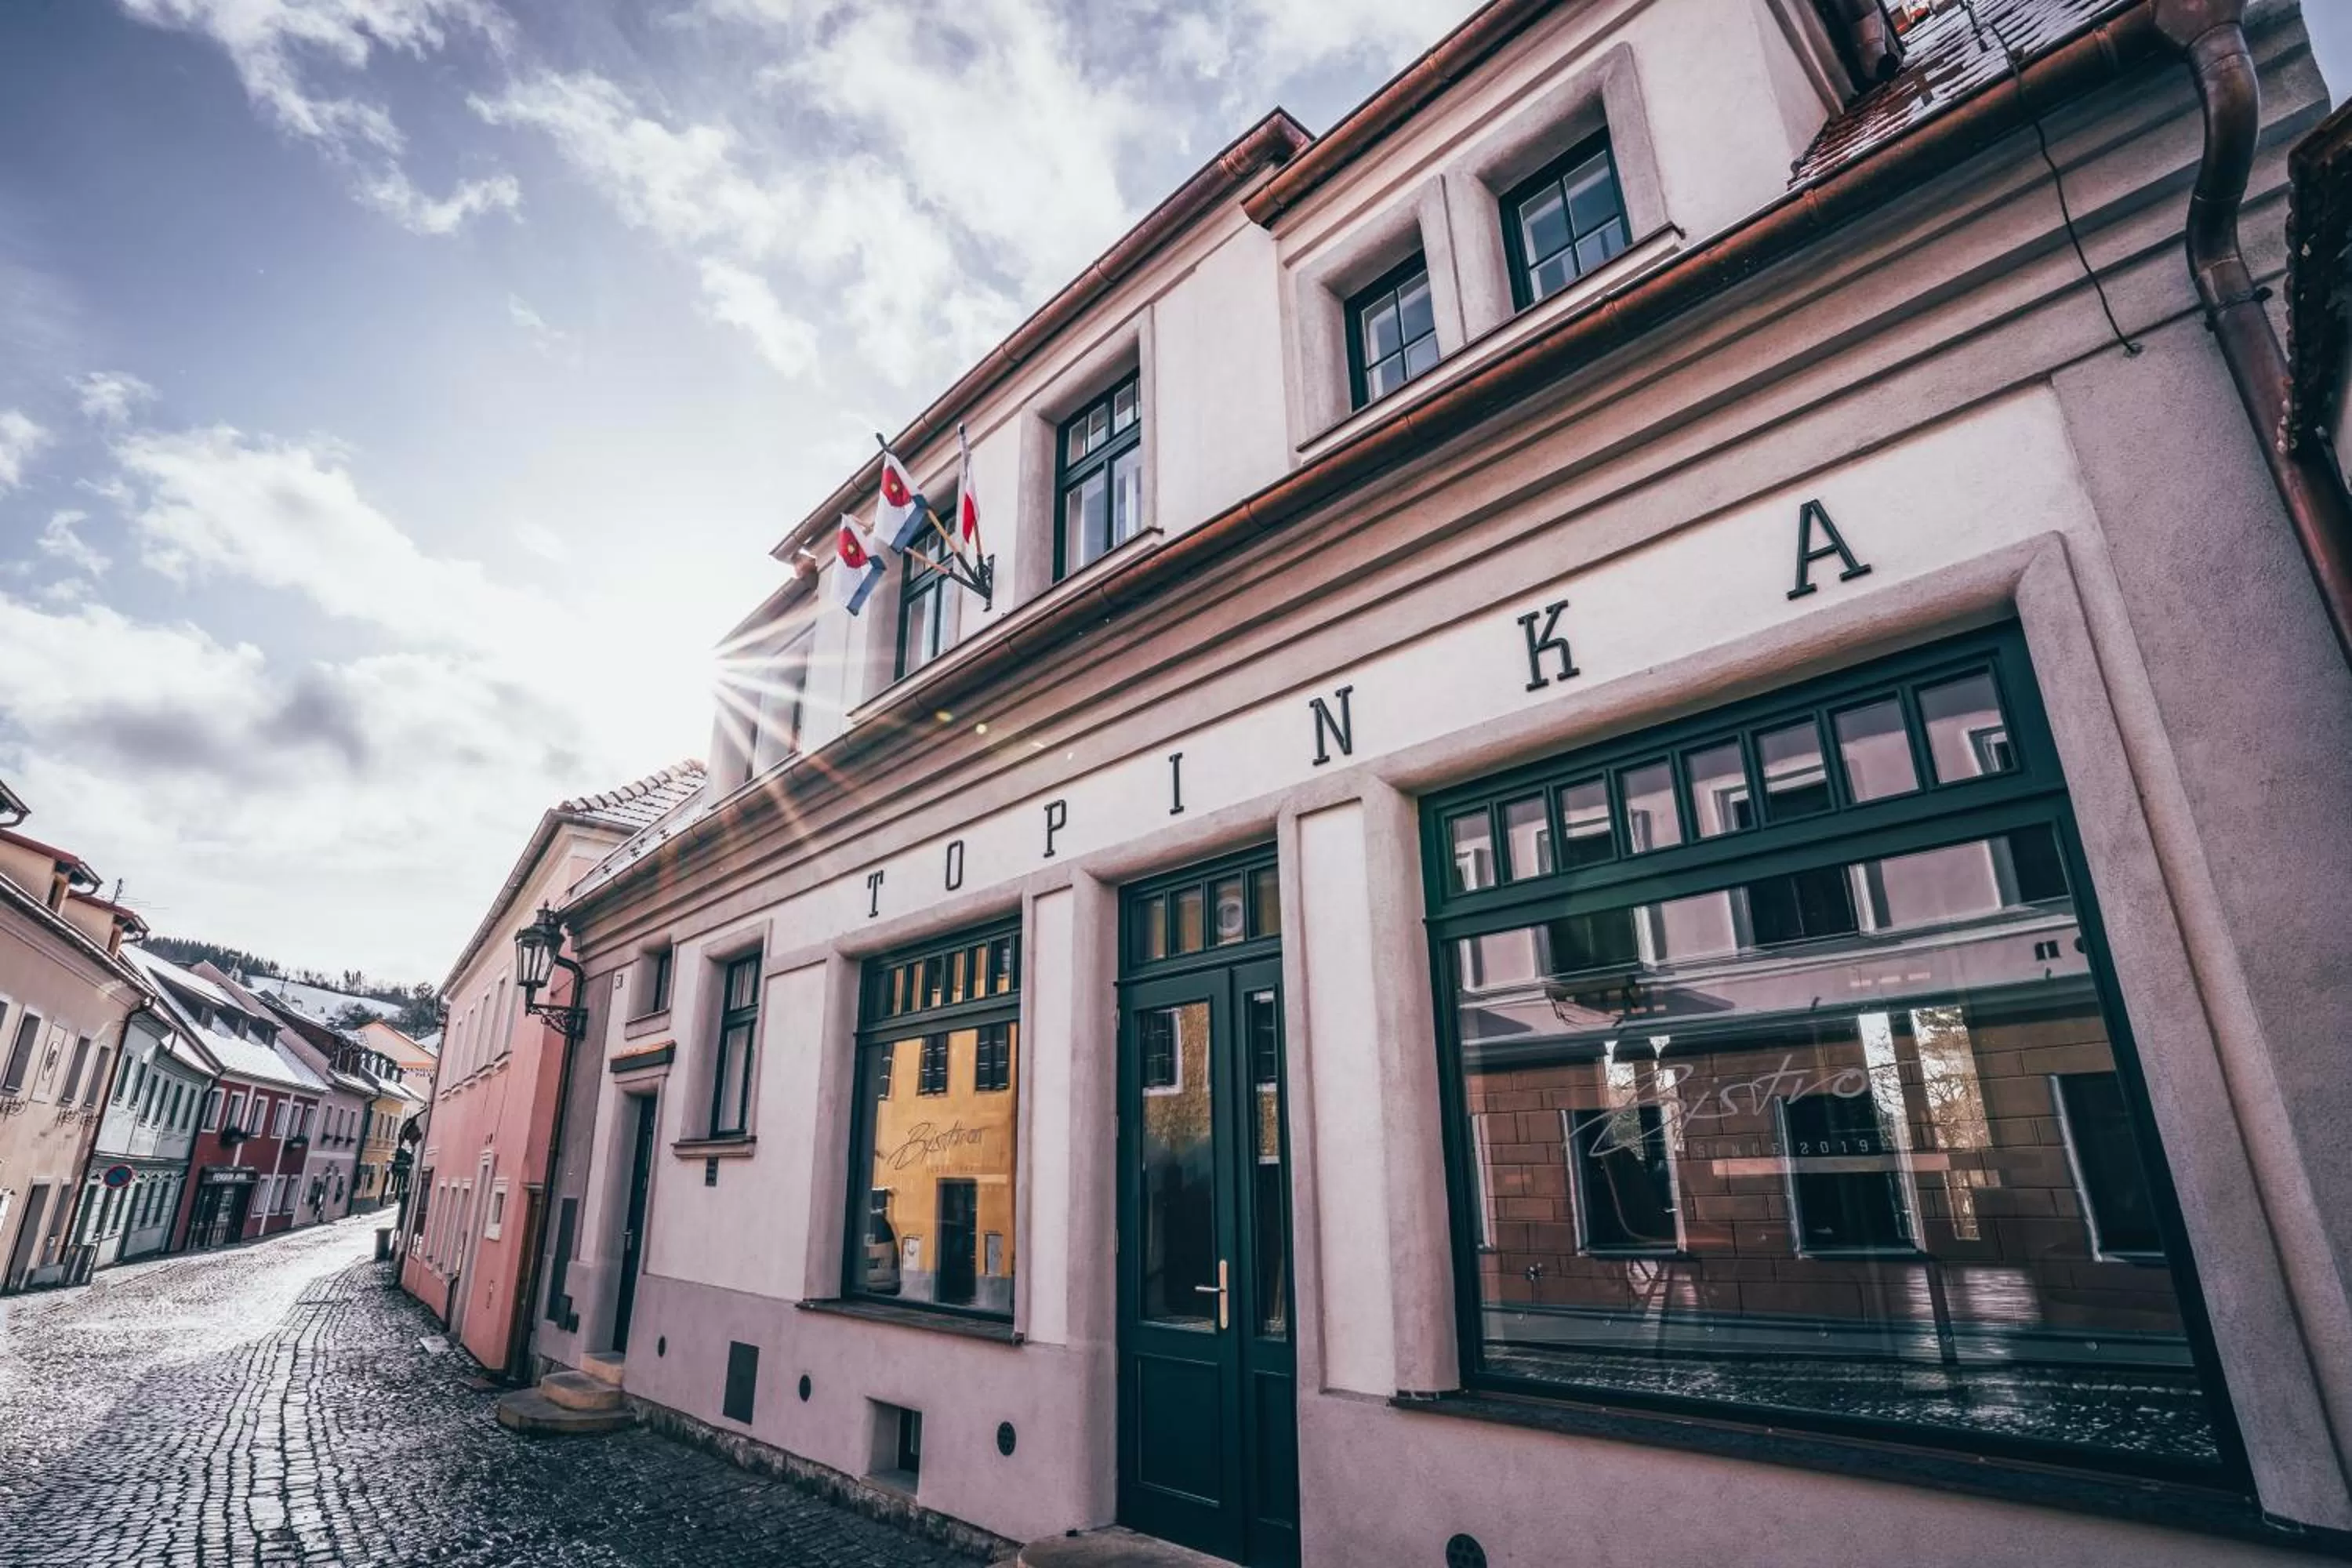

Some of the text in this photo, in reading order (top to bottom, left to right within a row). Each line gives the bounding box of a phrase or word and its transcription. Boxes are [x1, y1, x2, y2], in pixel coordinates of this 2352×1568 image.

[867, 498, 1873, 918] TOPINKA
[1567, 1054, 1913, 1157] Bistro
[1799, 1139, 1869, 1155] 2019
